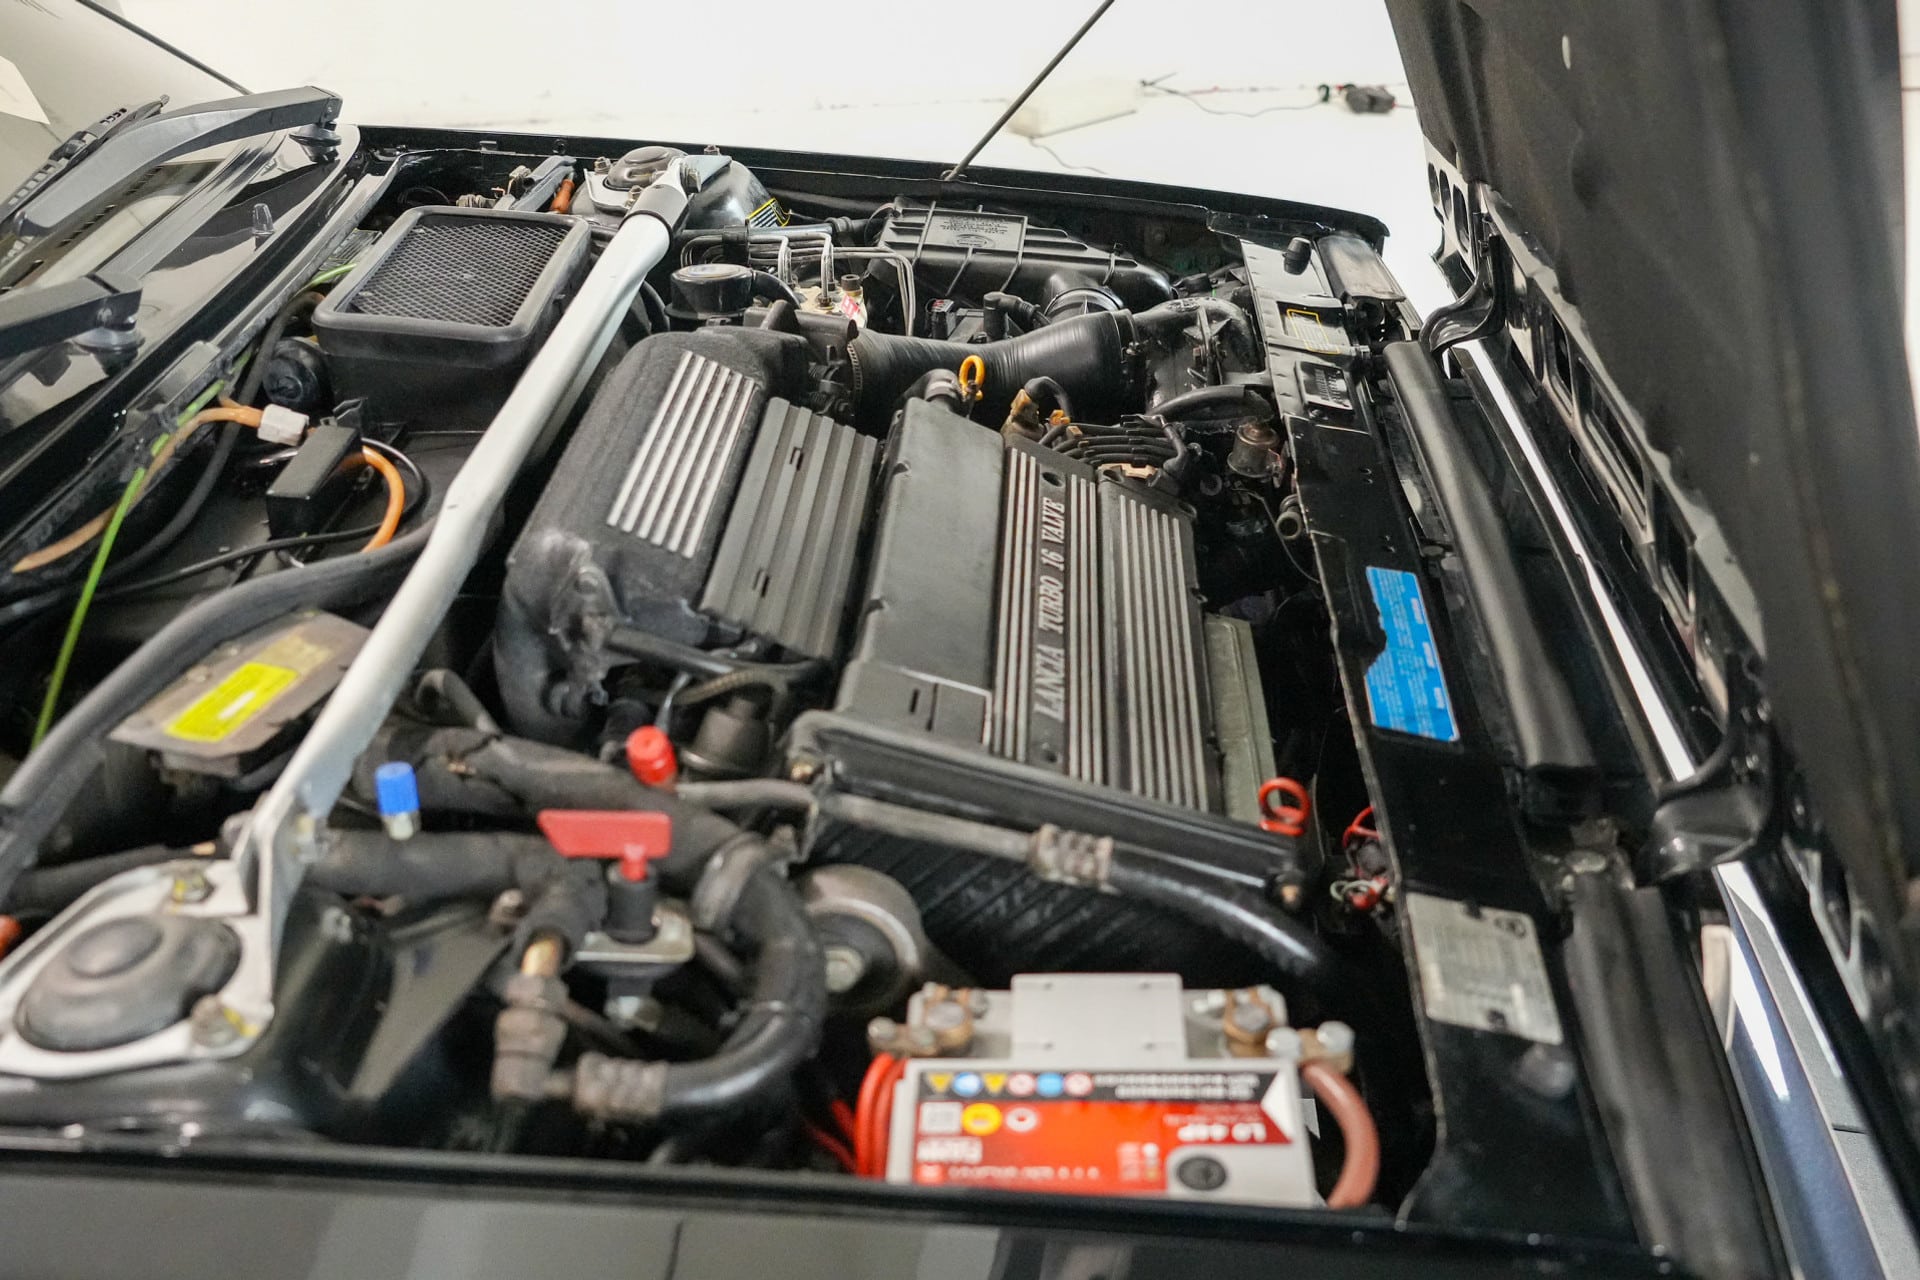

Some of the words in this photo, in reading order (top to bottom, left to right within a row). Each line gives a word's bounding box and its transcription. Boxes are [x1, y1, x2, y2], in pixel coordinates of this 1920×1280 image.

[1041, 497, 1065, 544] VALVE
[1041, 548, 1065, 571] 16
[1038, 575, 1064, 635] TURBO
[1034, 645, 1065, 723] LANCIA
